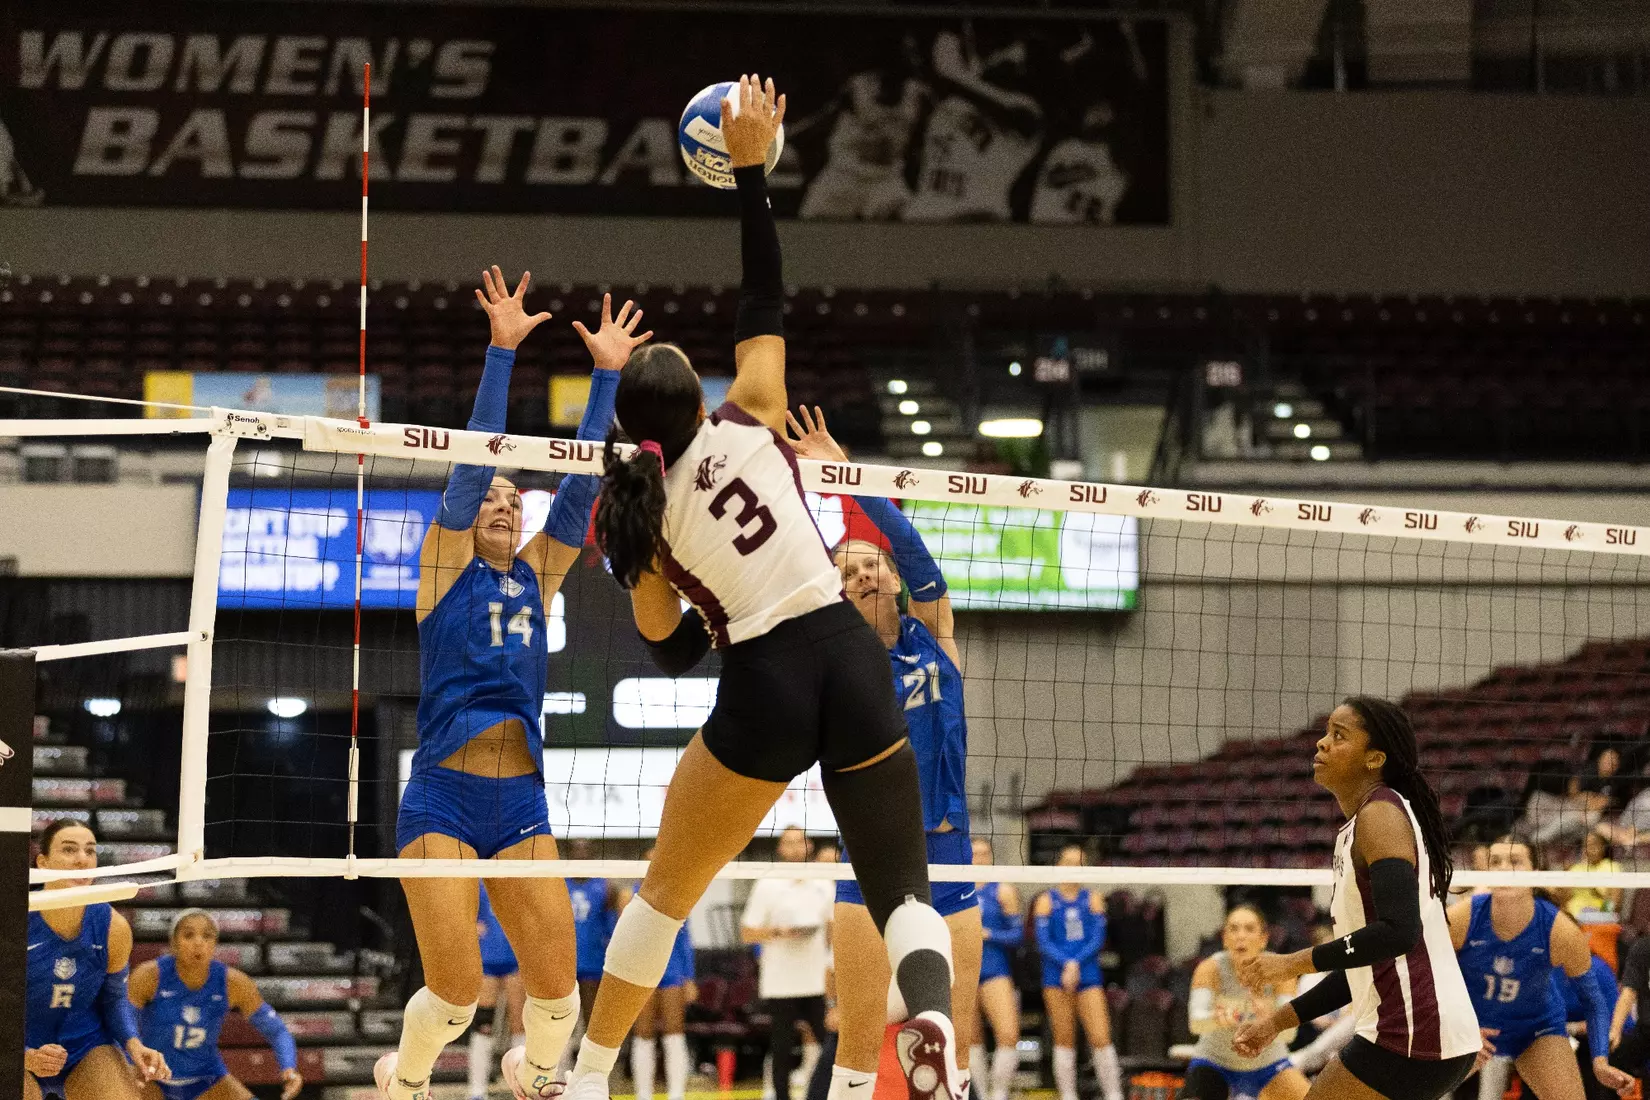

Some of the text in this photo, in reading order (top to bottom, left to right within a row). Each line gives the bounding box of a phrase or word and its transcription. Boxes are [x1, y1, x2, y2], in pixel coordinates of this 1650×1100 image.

[17, 30, 496, 98] WOMEN'S
[72, 106, 805, 187] BASKETBA
[234, 414, 260, 424] Senoh
[404, 427, 450, 451] SIU
[549, 440, 594, 462] SIU
[821, 465, 862, 486] SIU
[948, 475, 987, 495] SIU
[1070, 484, 1108, 503] SIU
[1186, 494, 1222, 513] SIU
[708, 477, 777, 556] 3
[1298, 503, 1332, 522] SIU
[1405, 512, 1438, 530] SIU
[1507, 520, 1539, 539] SIU
[1605, 528, 1636, 546] SIU
[488, 602, 533, 648] 14
[903, 661, 943, 710] 21
